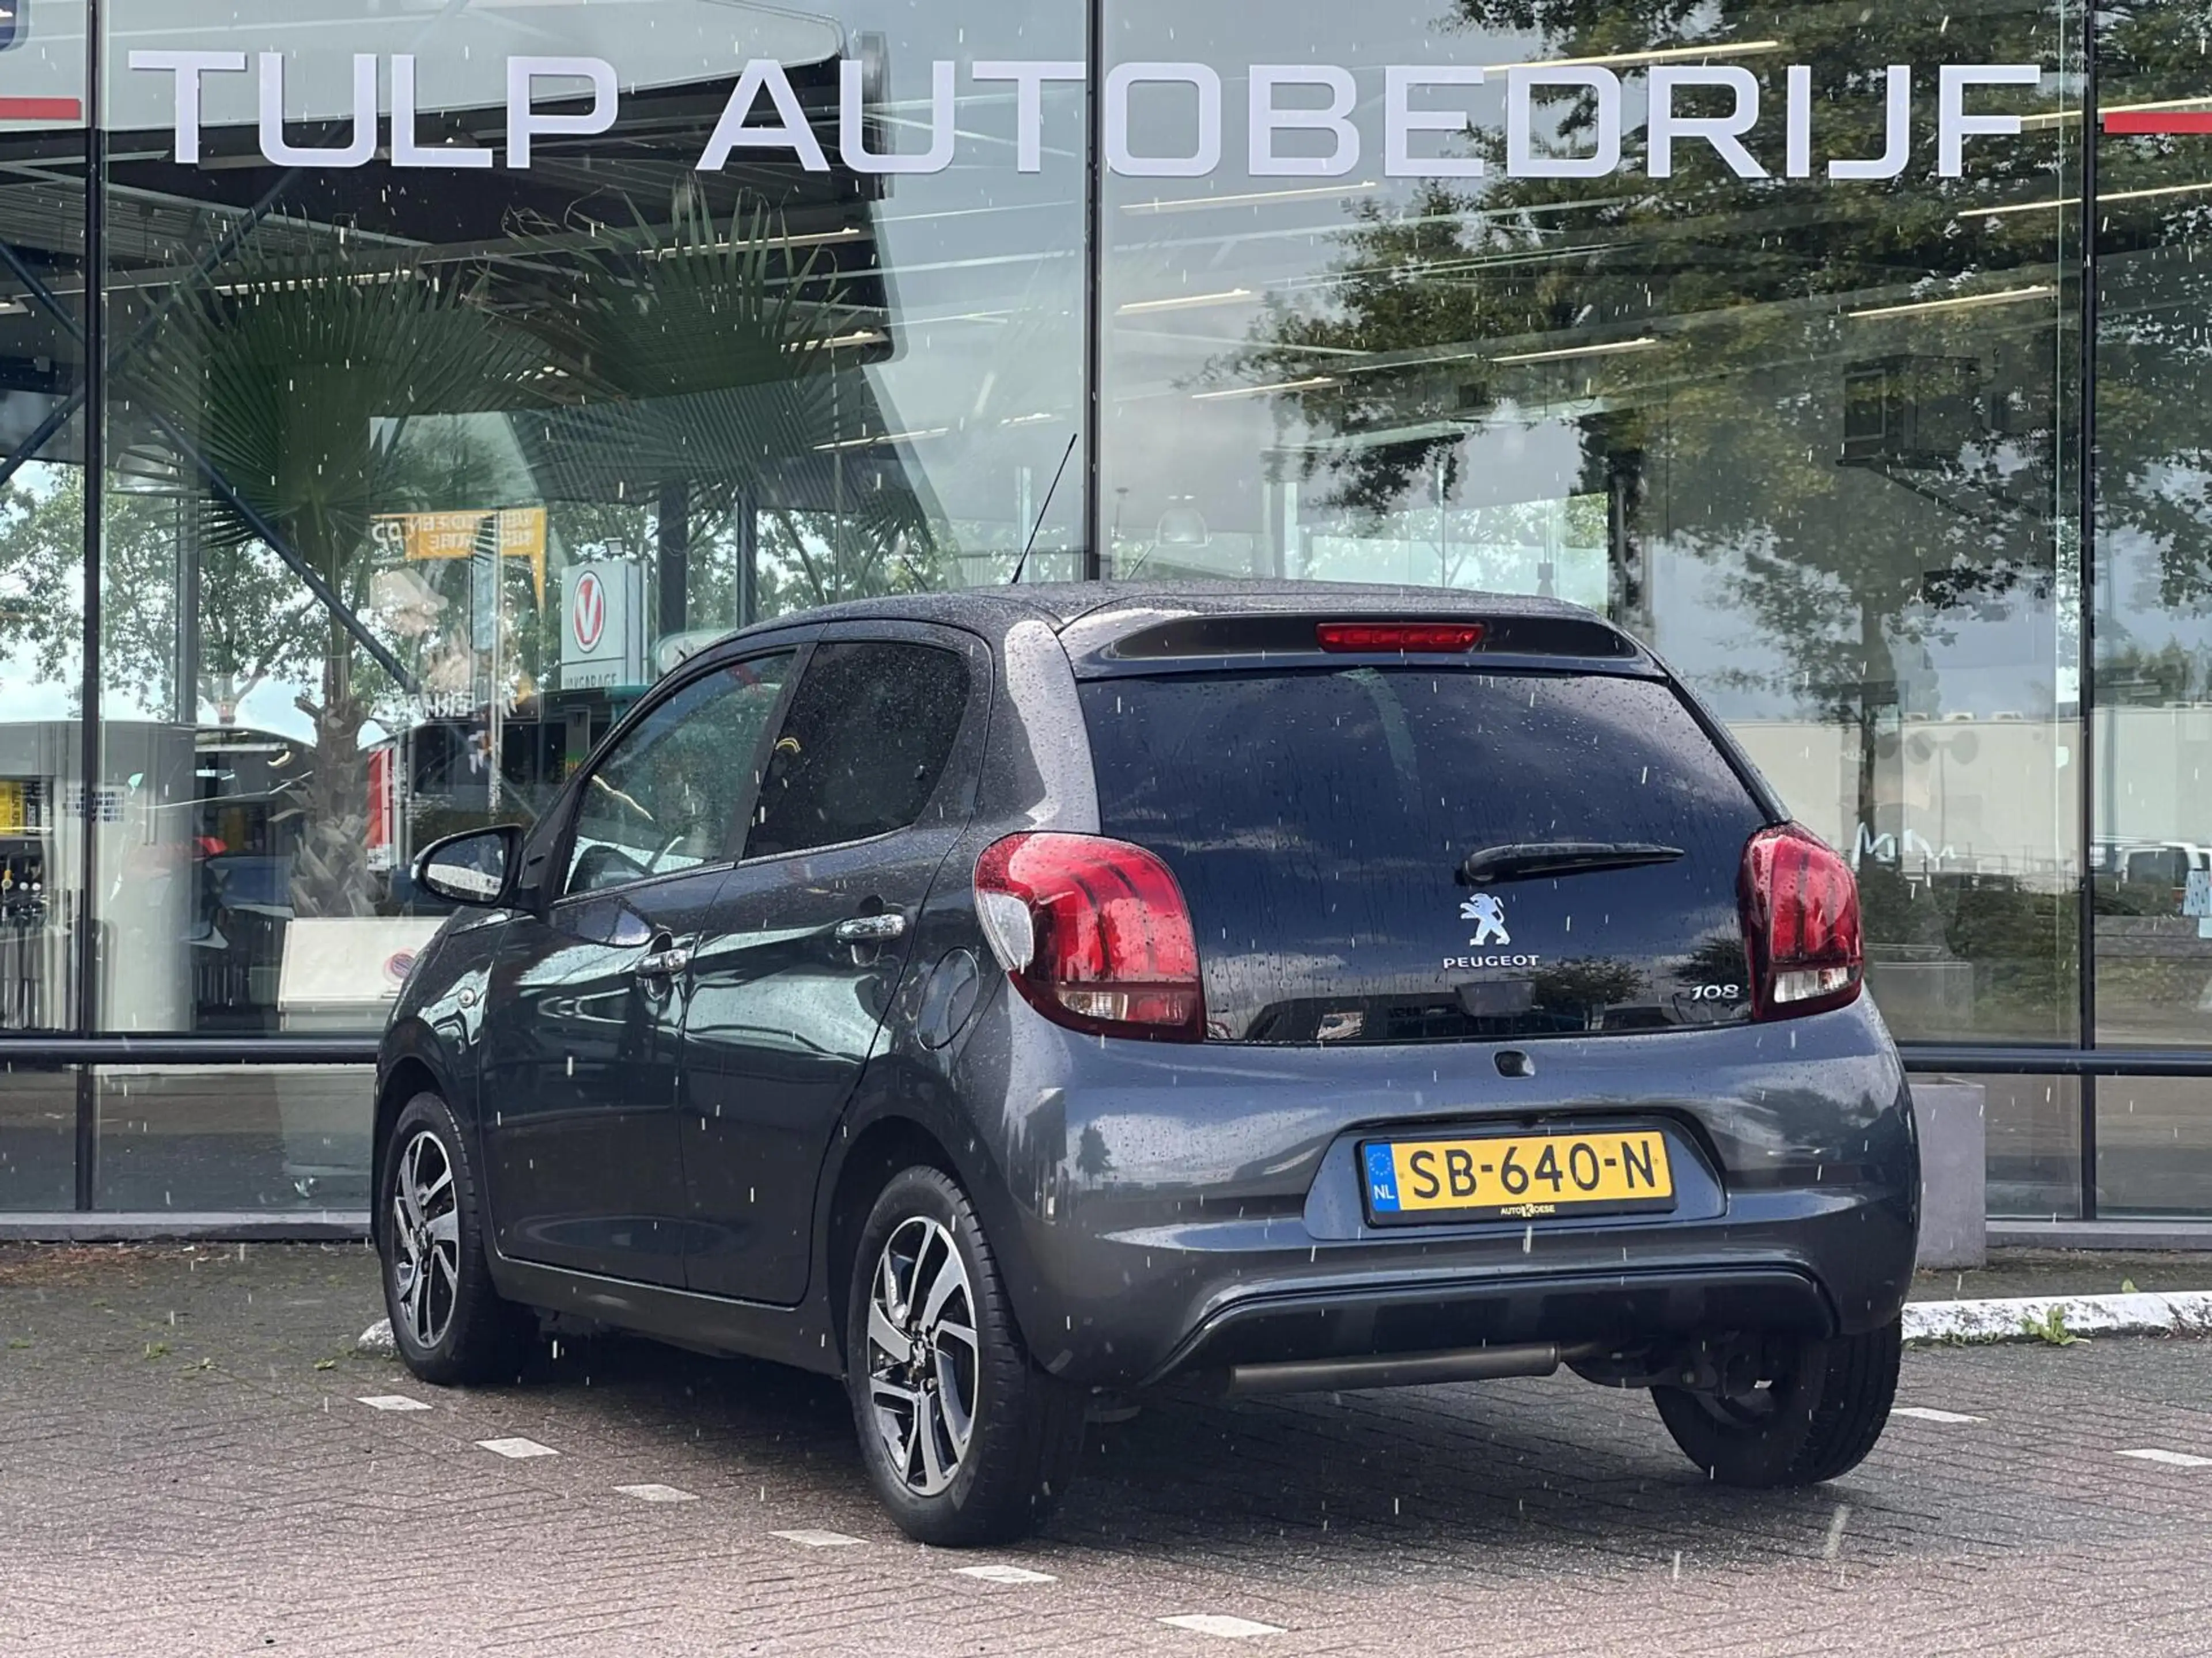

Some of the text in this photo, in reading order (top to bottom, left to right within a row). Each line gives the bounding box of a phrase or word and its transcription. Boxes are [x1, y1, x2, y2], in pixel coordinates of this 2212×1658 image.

[128, 50, 2040, 179] TULP AUTOBEDRIJF
[1443, 954, 1540, 969] PEUGEOT
[1691, 984, 1739, 1001] 108
[1409, 1140, 1655, 1199] SB-640-N
[1373, 1184, 1395, 1201] NL
